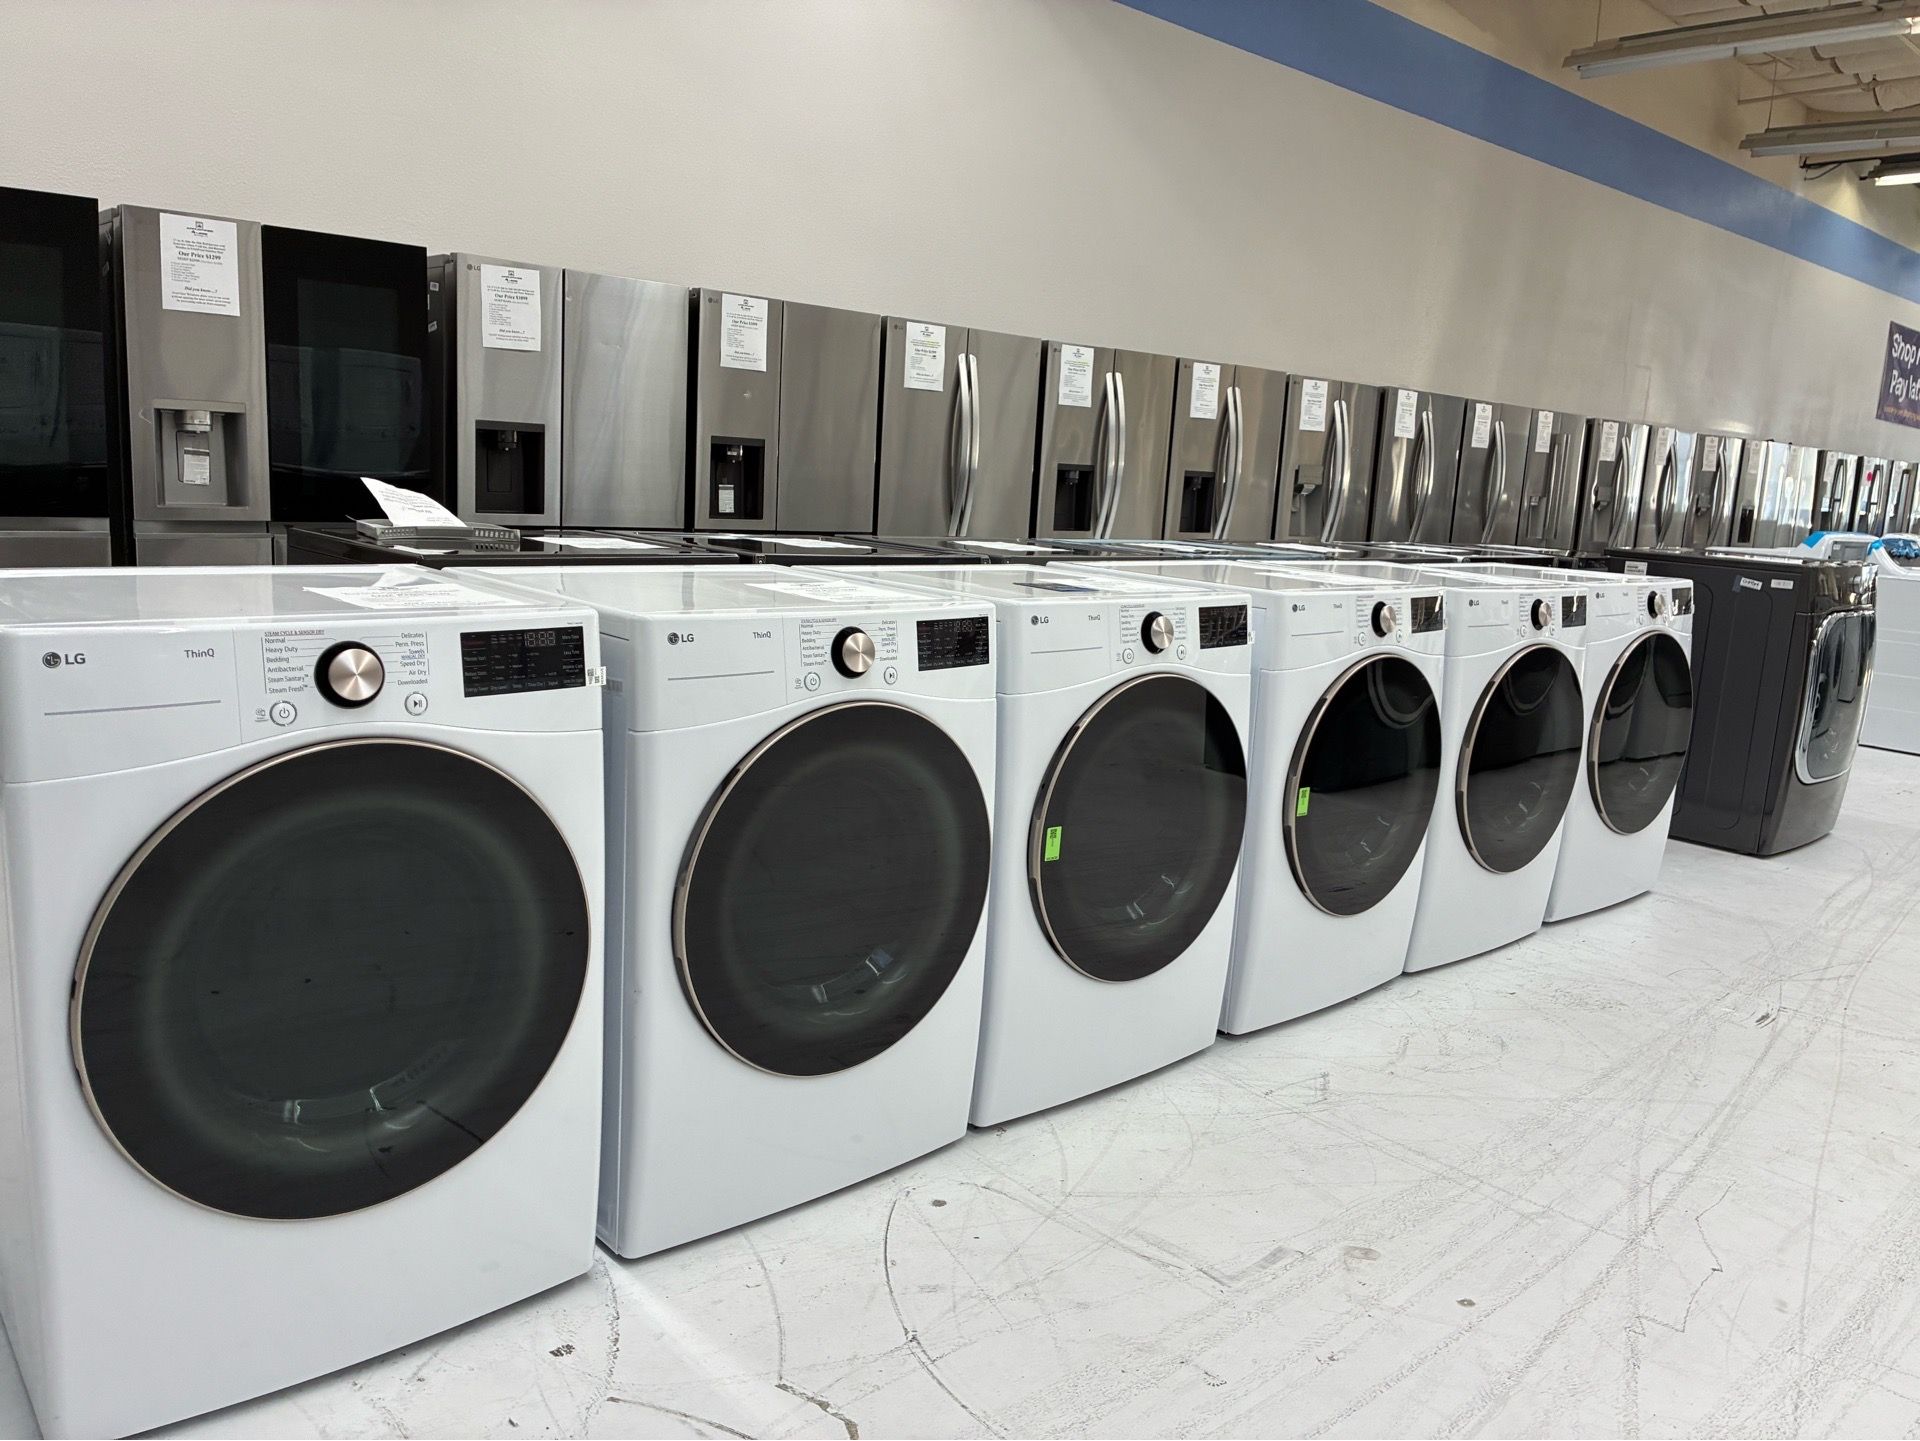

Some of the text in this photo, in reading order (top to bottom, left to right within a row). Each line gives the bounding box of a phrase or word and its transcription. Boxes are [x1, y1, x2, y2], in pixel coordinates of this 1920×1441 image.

[1892, 333, 1917, 369] Shop
[1889, 369, 1920, 403] Pay lat
[401, 632, 424, 640] Delicates
[680, 633, 695, 643] LG
[752, 630, 772, 640] ThinQ
[410, 640, 424, 648] Press
[184, 648, 216, 659] ThinQ
[64, 653, 86, 665] LG
[266, 656, 290, 664] Bedding
[416, 660, 426, 668] Dry
[267, 665, 304, 673] Antibacterial
[268, 676, 284, 684] Steam
[397, 678, 428, 686] Downloaded
